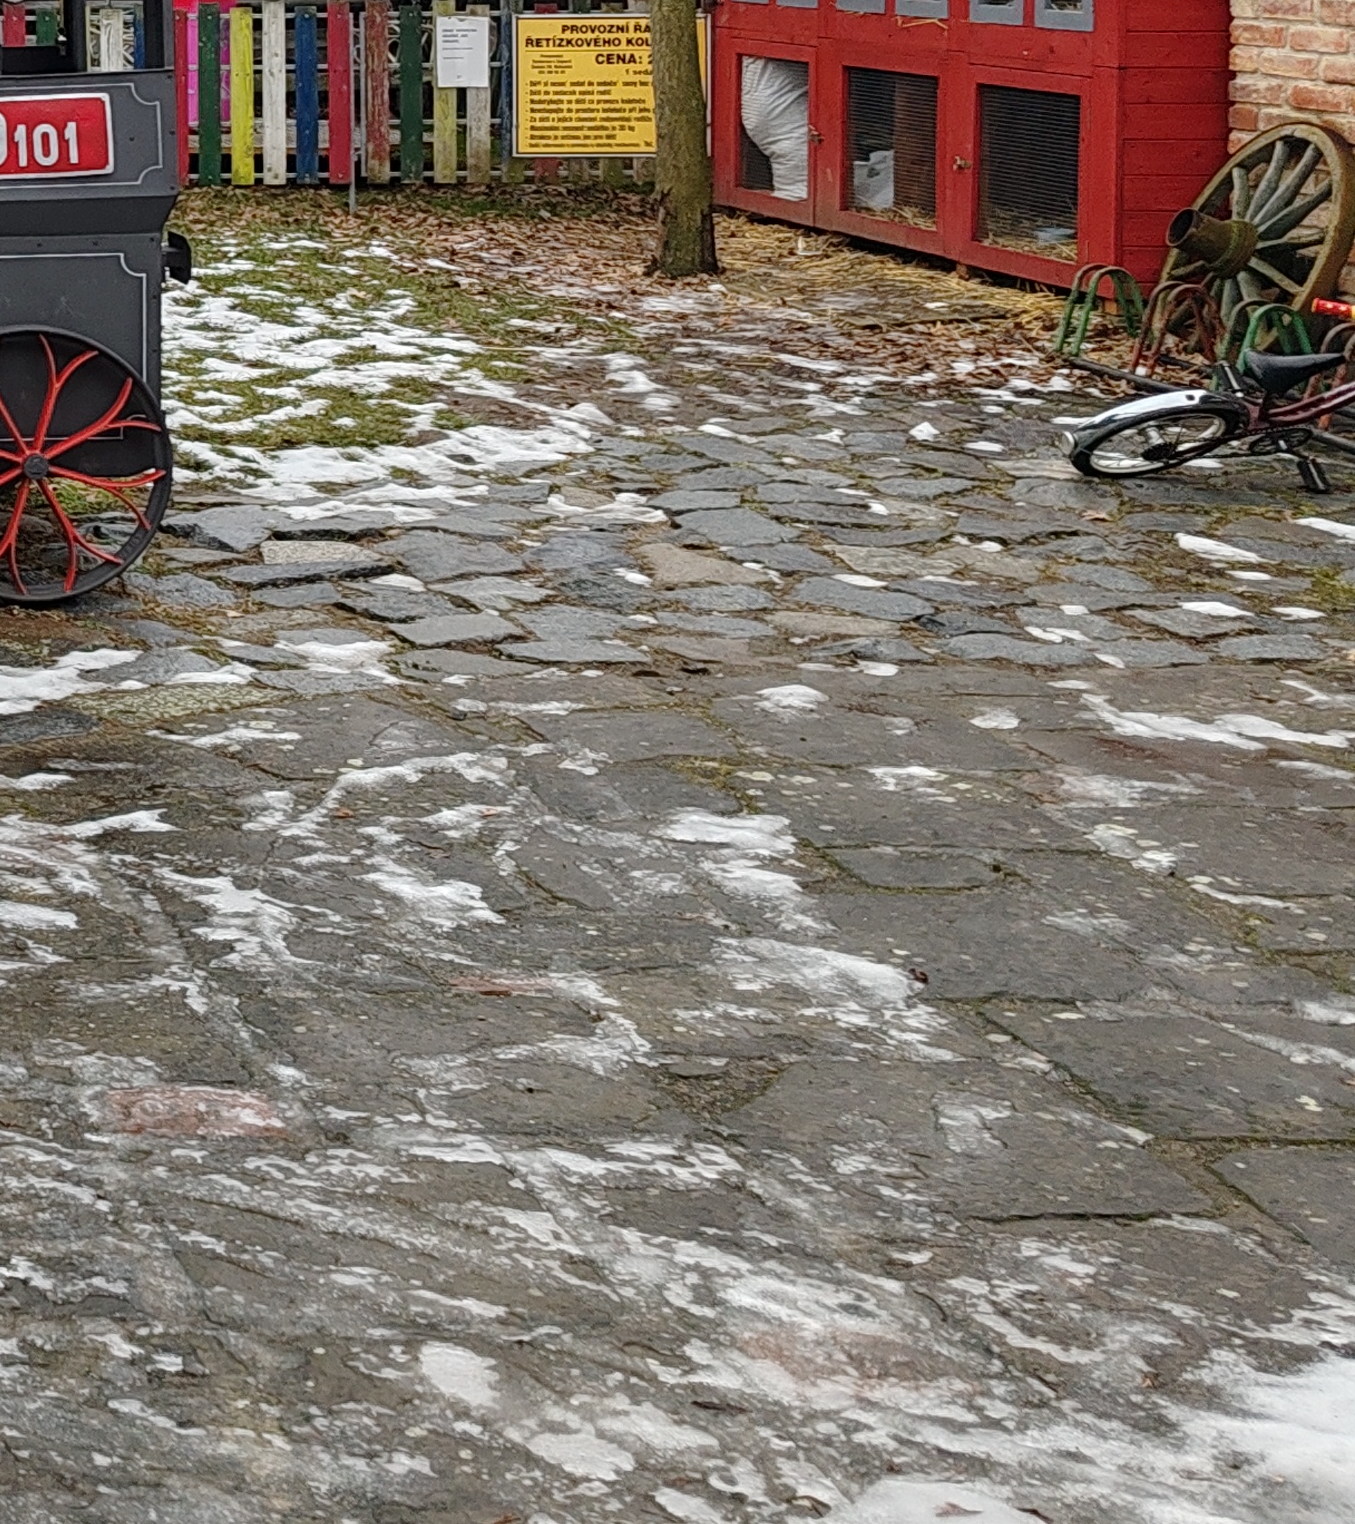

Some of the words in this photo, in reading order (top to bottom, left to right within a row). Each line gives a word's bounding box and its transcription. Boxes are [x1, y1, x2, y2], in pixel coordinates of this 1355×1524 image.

[561, 21, 629, 34] PROVOZNÍ
[525, 35, 622, 48] ŘETÍZKOVÉHO
[595, 53, 643, 65] CENA:
